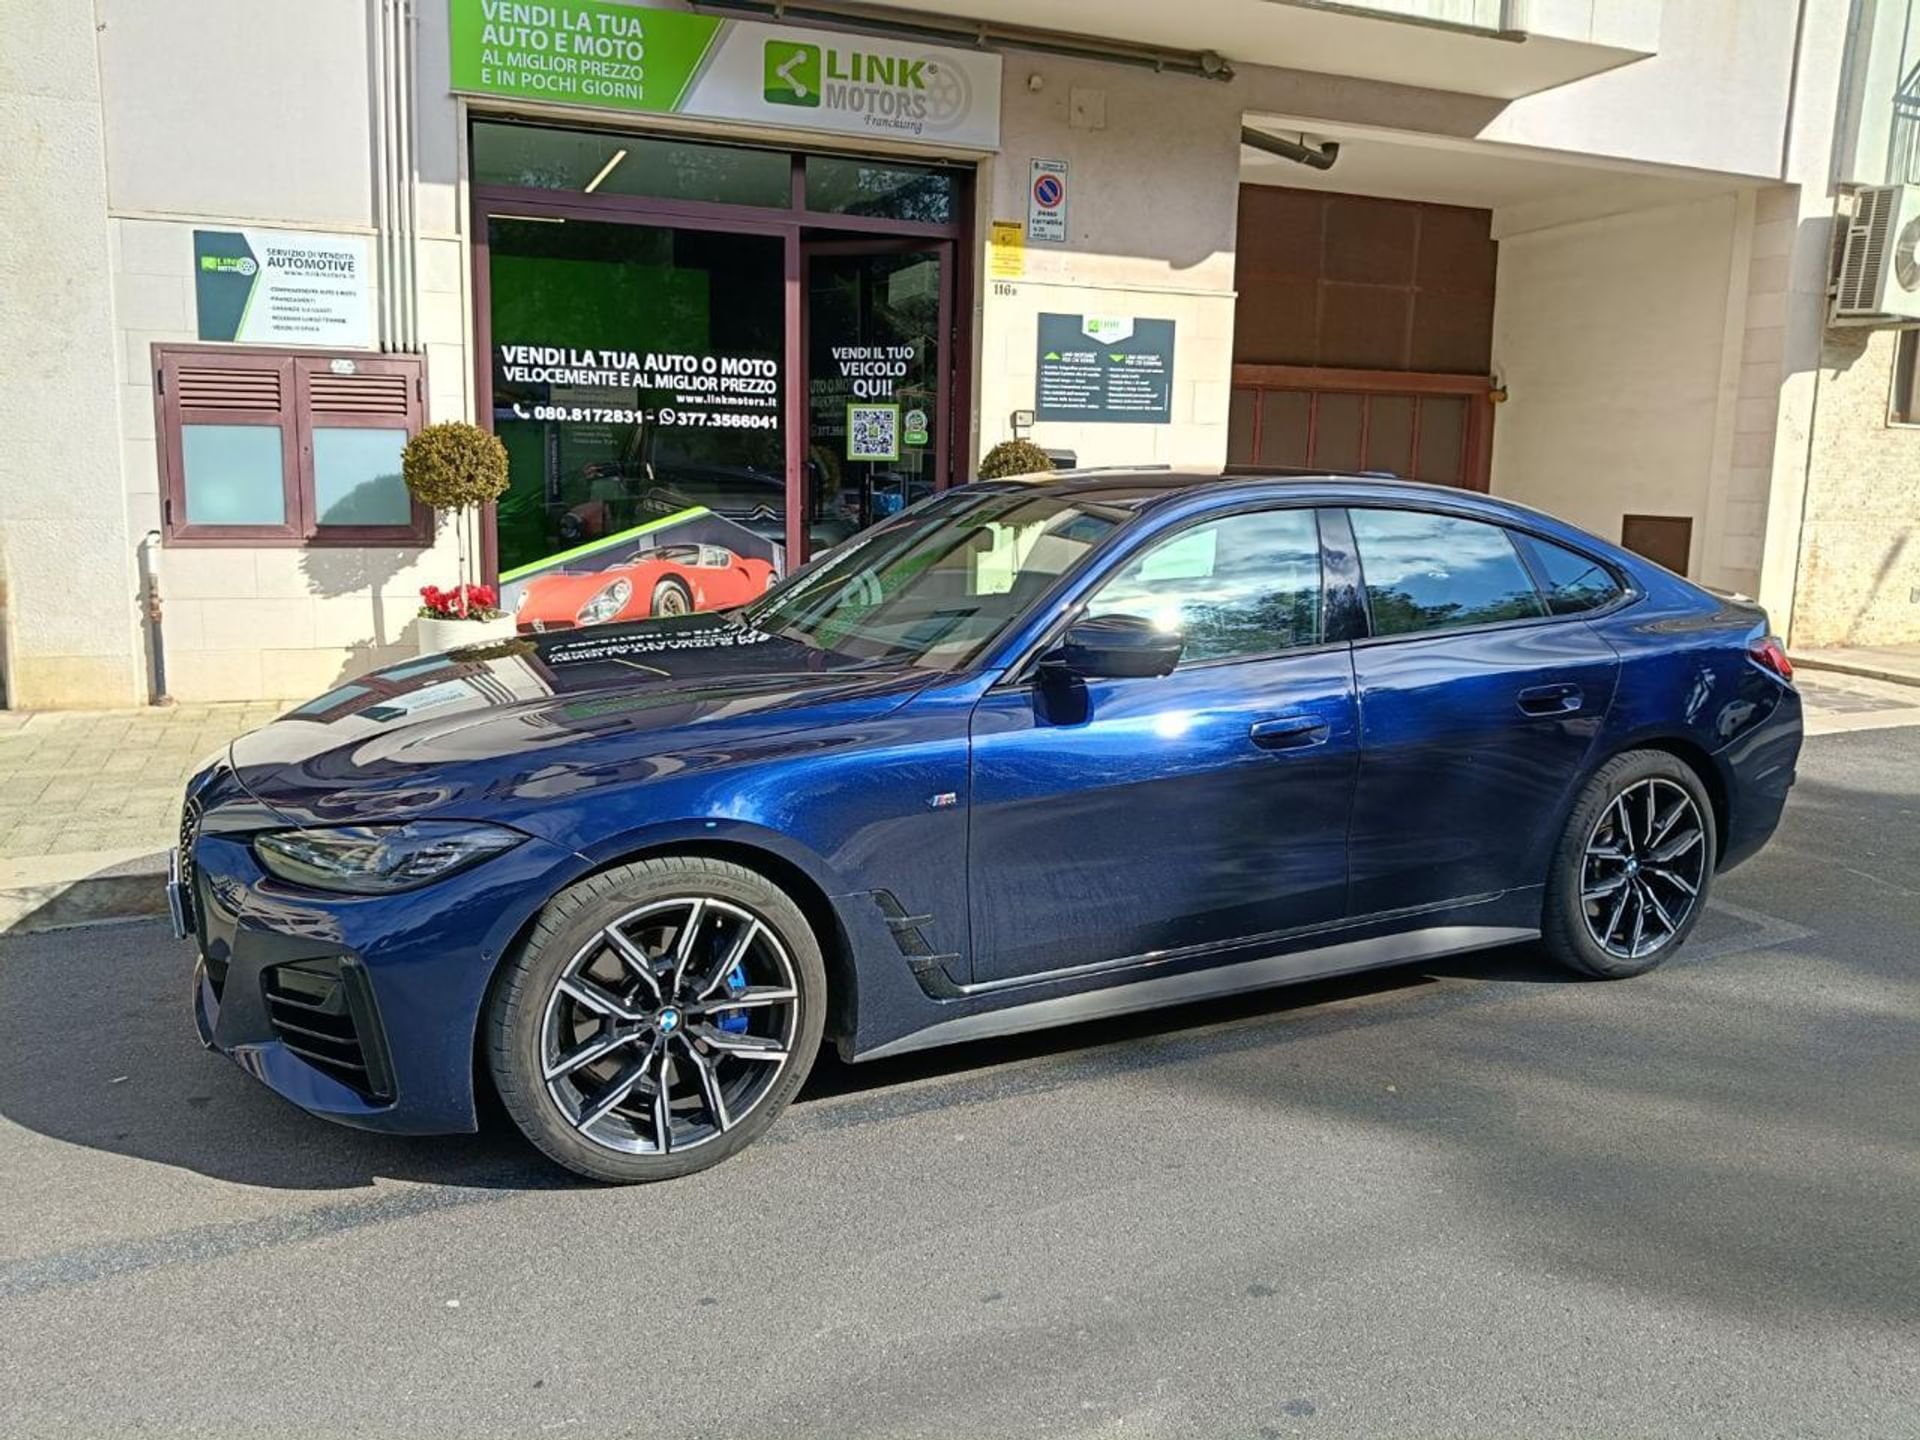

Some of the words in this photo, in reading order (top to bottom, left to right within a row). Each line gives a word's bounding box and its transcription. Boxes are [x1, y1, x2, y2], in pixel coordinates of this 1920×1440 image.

[481, 0, 556, 28] VENDI
[562, 9, 592, 33] LA
[597, 14, 644, 39] TUA
[481, 24, 549, 50] AUTO
[555, 32, 568, 53] E
[574, 35, 644, 62] MOTO
[481, 49, 503, 66] AL
[506, 52, 577, 74] MIGLIOR
[581, 60, 644, 82] PREZZO
[481, 68, 492, 84] E
[497, 70, 515, 87] IN
[521, 72, 577, 93] POCHI
[582, 79, 644, 100] GIORNI
[825, 83, 928, 120] MOTORS
[266, 247, 306, 258] SERVIZIO
[307, 249, 317, 259] DI
[317, 251, 355, 261] VENDITA
[267, 256, 355, 273] AUTOMOTIVE
[501, 345, 567, 367] VENDI
[570, 348, 597, 368] LA
[599, 350, 641, 371] TUA
[644, 353, 699, 374] AUTO
[701, 356, 717, 375] O
[721, 357, 777, 378] MOTO
[832, 346, 872, 360] VENDI
[873, 347, 885, 359] IL
[886, 346, 915, 360] TUO
[502, 365, 619, 387] VELOCEMENTE
[620, 372, 631, 388] E
[632, 373, 653, 389] AL
[655, 373, 718, 392] MIGLIOR
[721, 377, 777, 395] PREZZO
[839, 361, 907, 377] VEICOLO
[676, 394, 777, 408] www.linkmotors.it
[853, 378, 893, 399] QUI!
[534, 405, 643, 424] 080.8172831
[677, 411, 777, 430] 377.3566041
